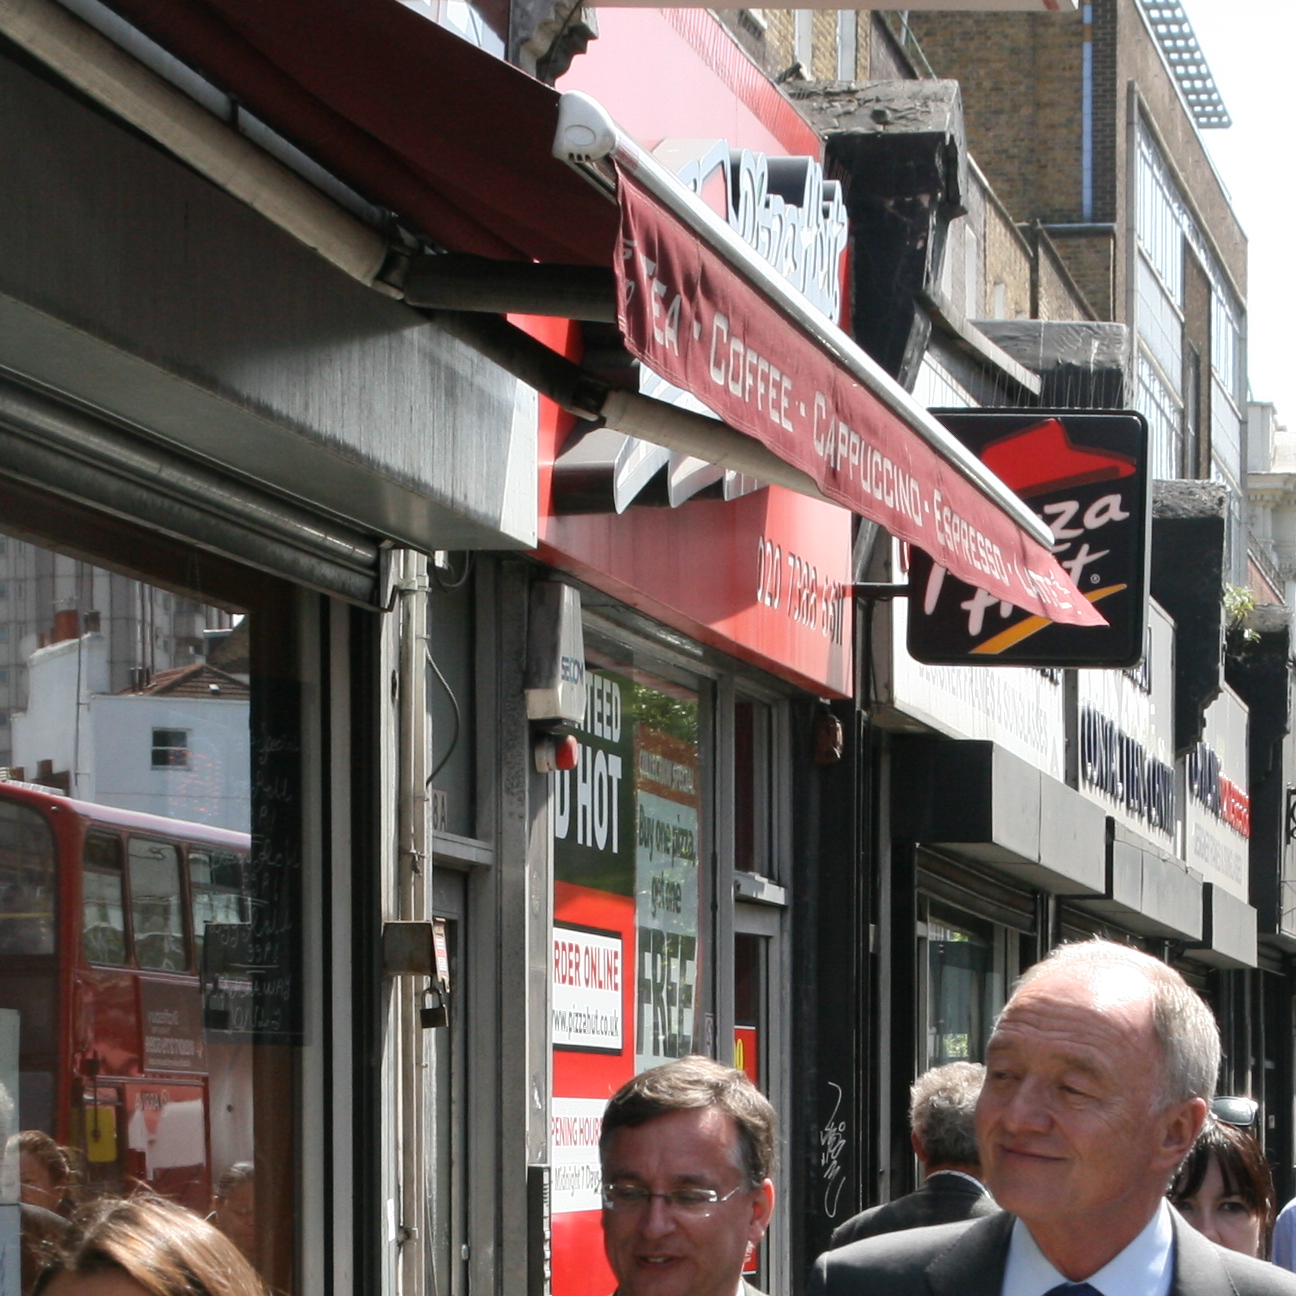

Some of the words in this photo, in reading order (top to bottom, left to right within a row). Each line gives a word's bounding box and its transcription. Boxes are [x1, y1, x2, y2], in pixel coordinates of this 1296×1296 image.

[710, 311, 794, 433] COFFEE
[813, 391, 923, 527] CAPPUCCINO
[934, 488, 1010, 587] ESPRESSO
[577, 743, 622, 854] HOT
[552, 940, 581, 988] RDER
[584, 945, 619, 992] ONLINE
[636, 925, 697, 1059] FREE
[552, 1004, 619, 1041] ww.pizzahut.co.uk
[551, 1116, 578, 1147] PENING
